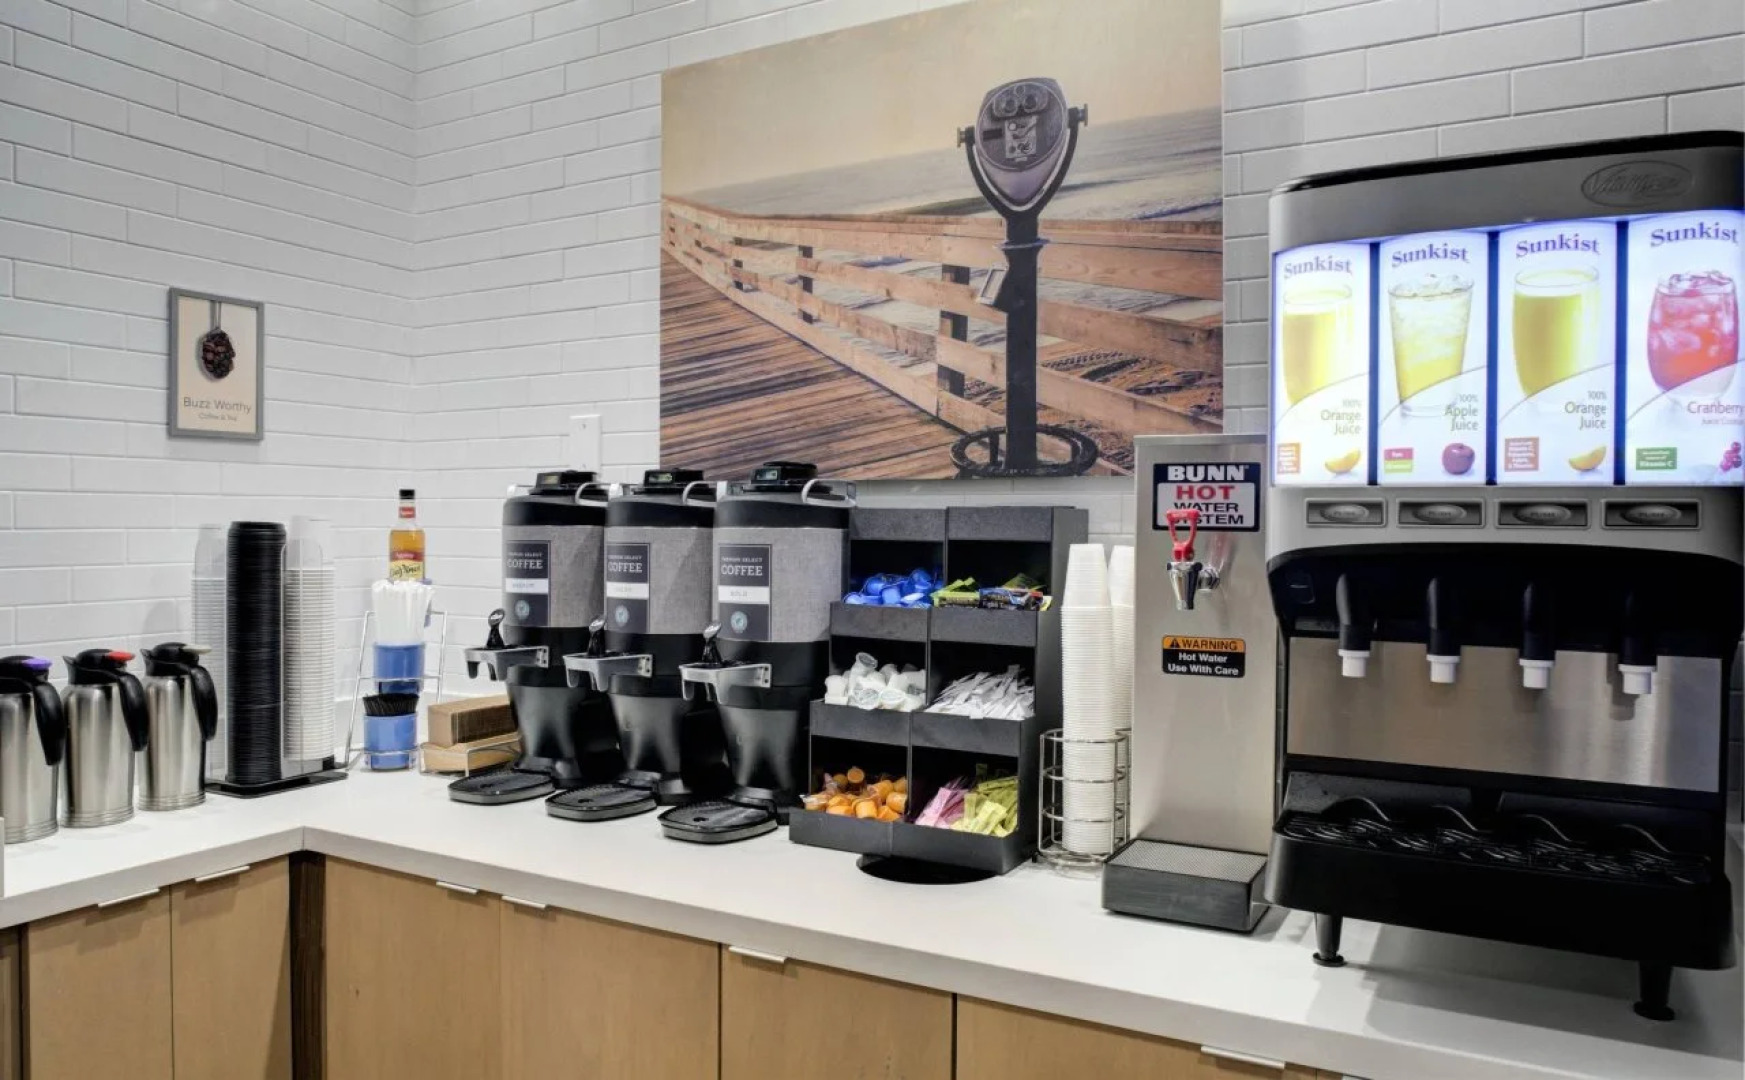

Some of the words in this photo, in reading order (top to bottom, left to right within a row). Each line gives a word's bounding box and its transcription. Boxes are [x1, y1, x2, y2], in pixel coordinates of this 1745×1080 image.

[1650, 221, 1739, 248] Sunkist
[1515, 233, 1600, 259] Sunkist
[1391, 243, 1469, 268] Sunkist
[1284, 255, 1353, 279] Sunkist
[1587, 391, 1606, 400] 100%
[183, 397, 211, 410] Buzz
[214, 398, 252, 415] Worthy
[1445, 405, 1478, 421] Apple
[1564, 401, 1606, 417] Orange
[1687, 401, 1744, 415] Cranberry
[1320, 409, 1361, 424] Orange
[1579, 416, 1606, 430] Juice
[1334, 422, 1361, 436] Juice
[1450, 419, 1479, 432] Juice
[1167, 465, 1244, 481] BUNN
[1176, 485, 1235, 500] HOT
[1174, 502, 1239, 513] WATER
[507, 559, 543, 570] COFFEE
[608, 562, 642, 573] COFFEE
[721, 565, 763, 576] COFFEE
[1181, 639, 1238, 651] WARNING
[1178, 652, 1197, 662] Hot
[1199, 653, 1228, 664] Water
[1167, 663, 1187, 673] Use
[1190, 664, 1212, 674] With
[1214, 666, 1239, 676] Care
